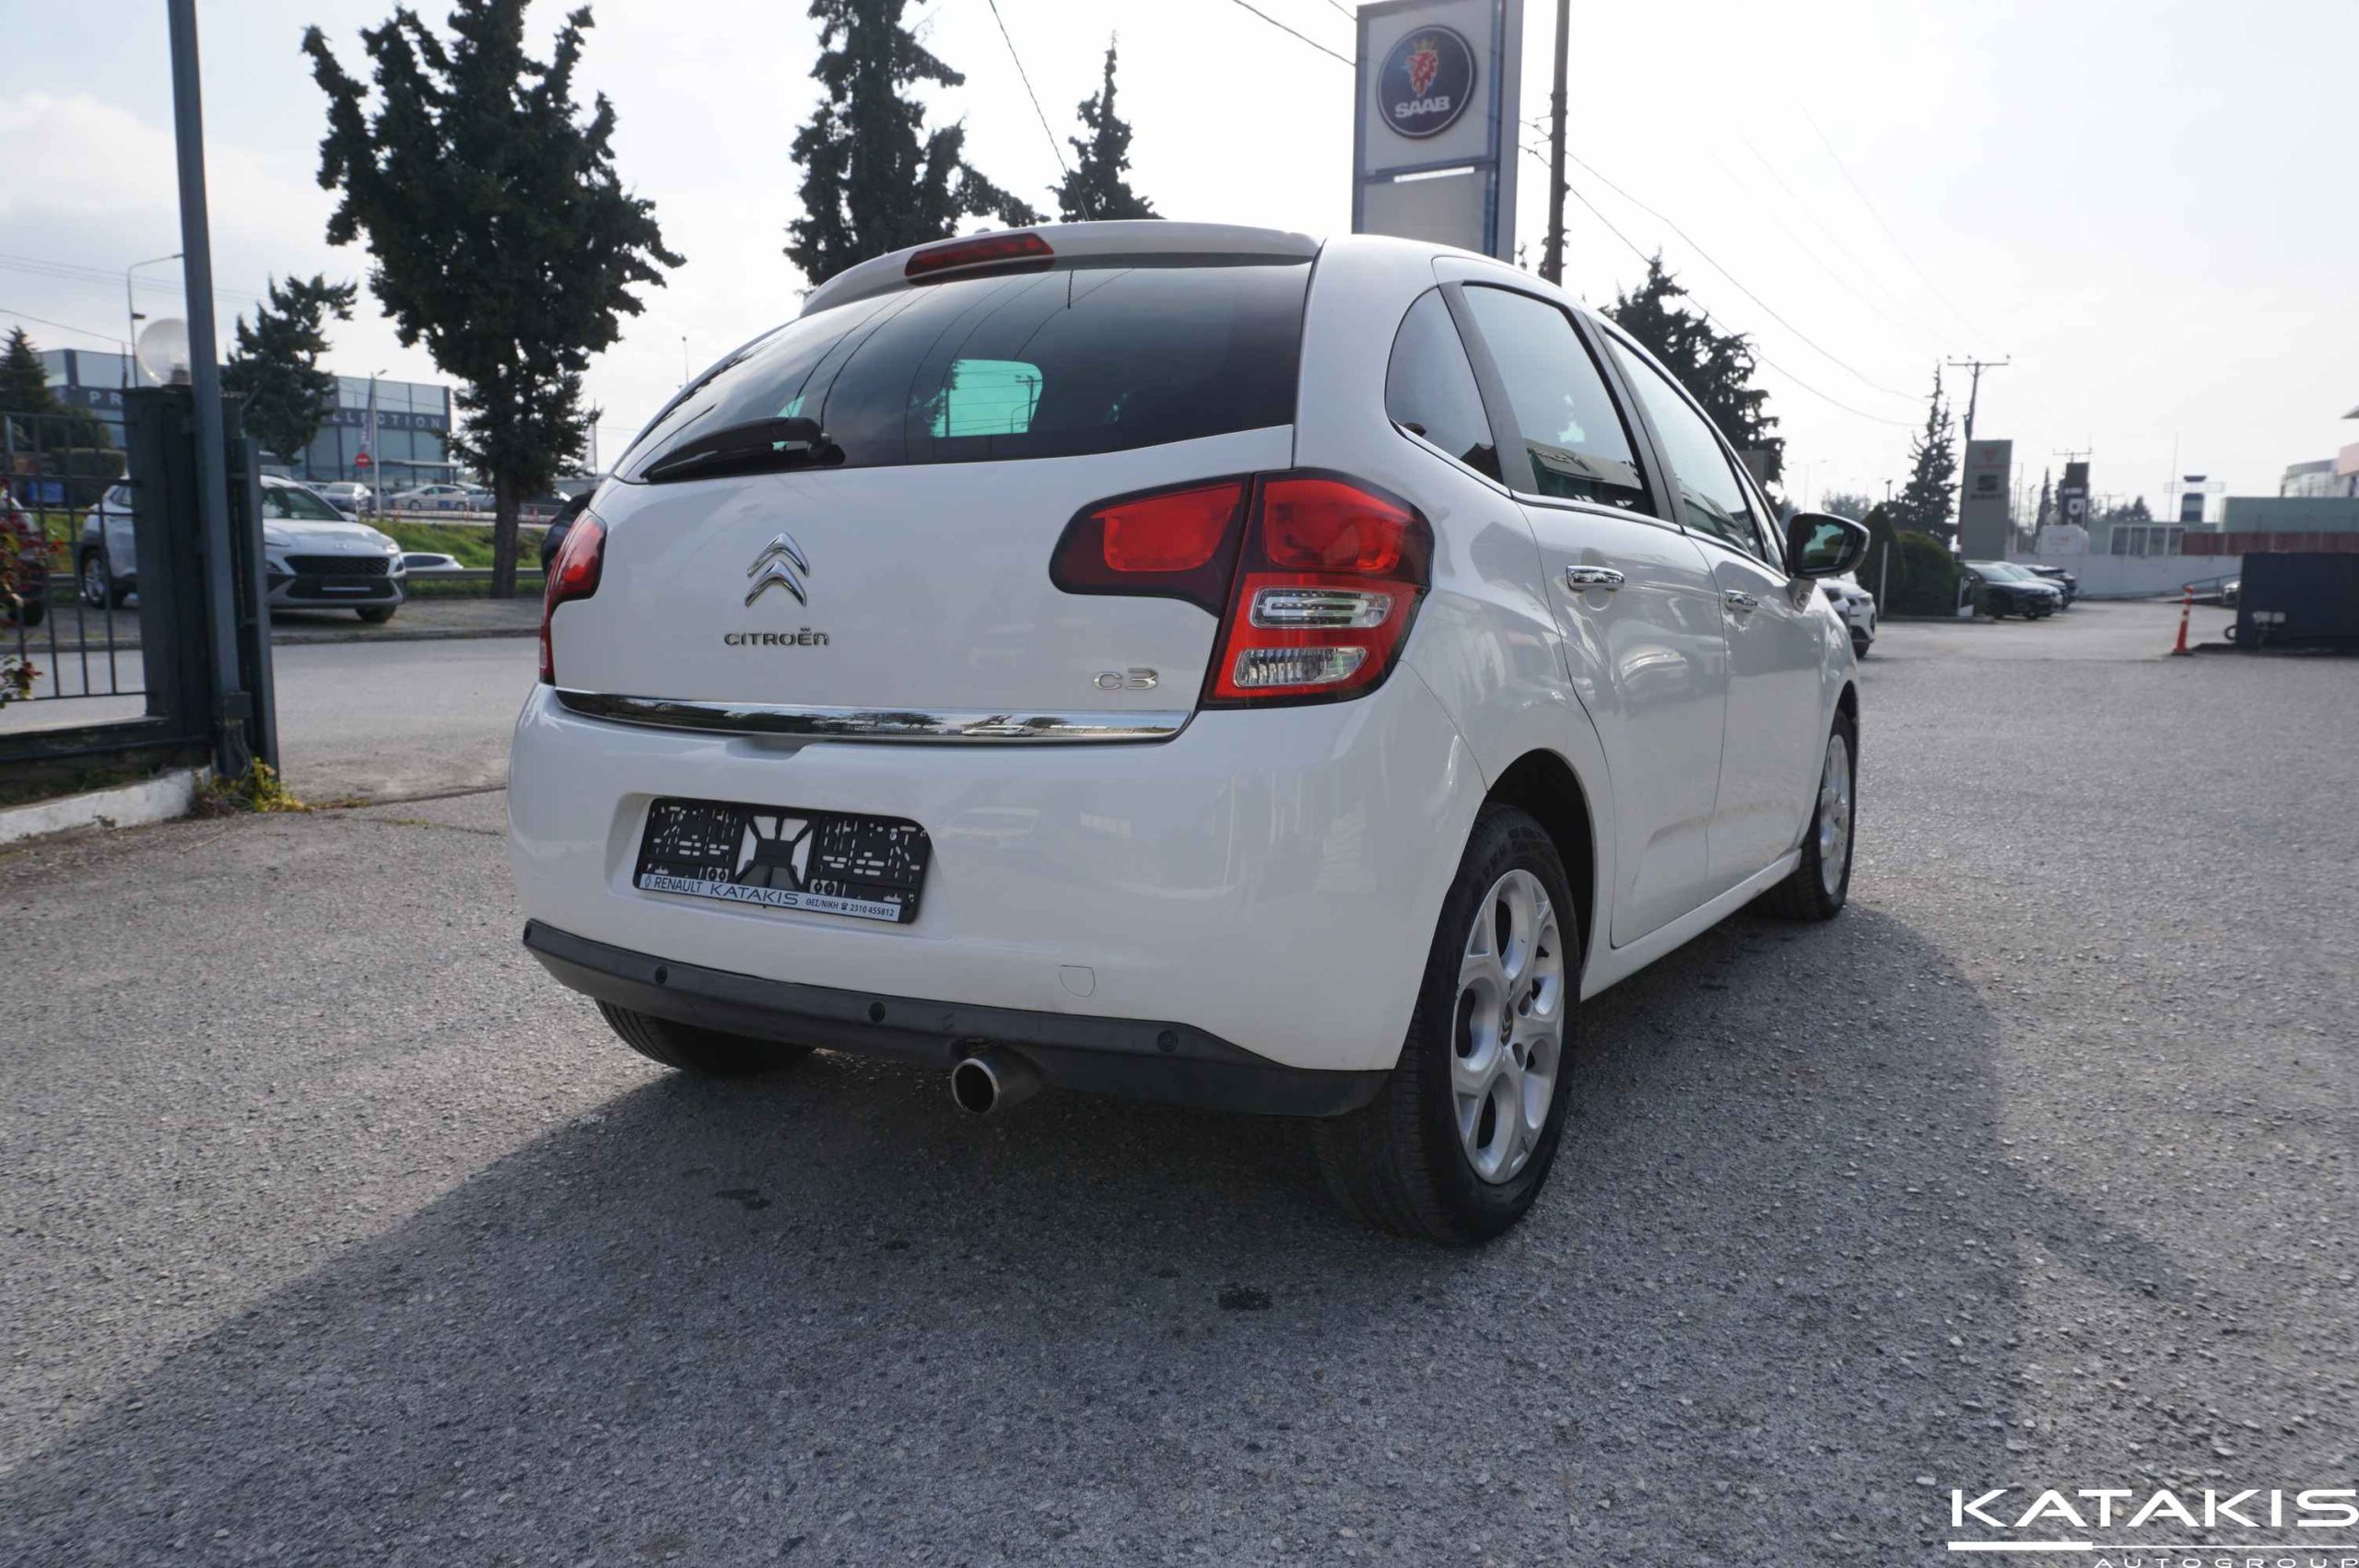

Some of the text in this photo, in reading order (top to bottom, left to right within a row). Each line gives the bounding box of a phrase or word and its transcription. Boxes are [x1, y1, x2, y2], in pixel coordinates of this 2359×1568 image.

[1394, 96, 1450, 119] SAAB
[1093, 668, 1158, 691] C3
[653, 876, 799, 906] RENAULT KATAKIS
[850, 904, 867, 914] 2310
[868, 907, 895, 918] 455812
